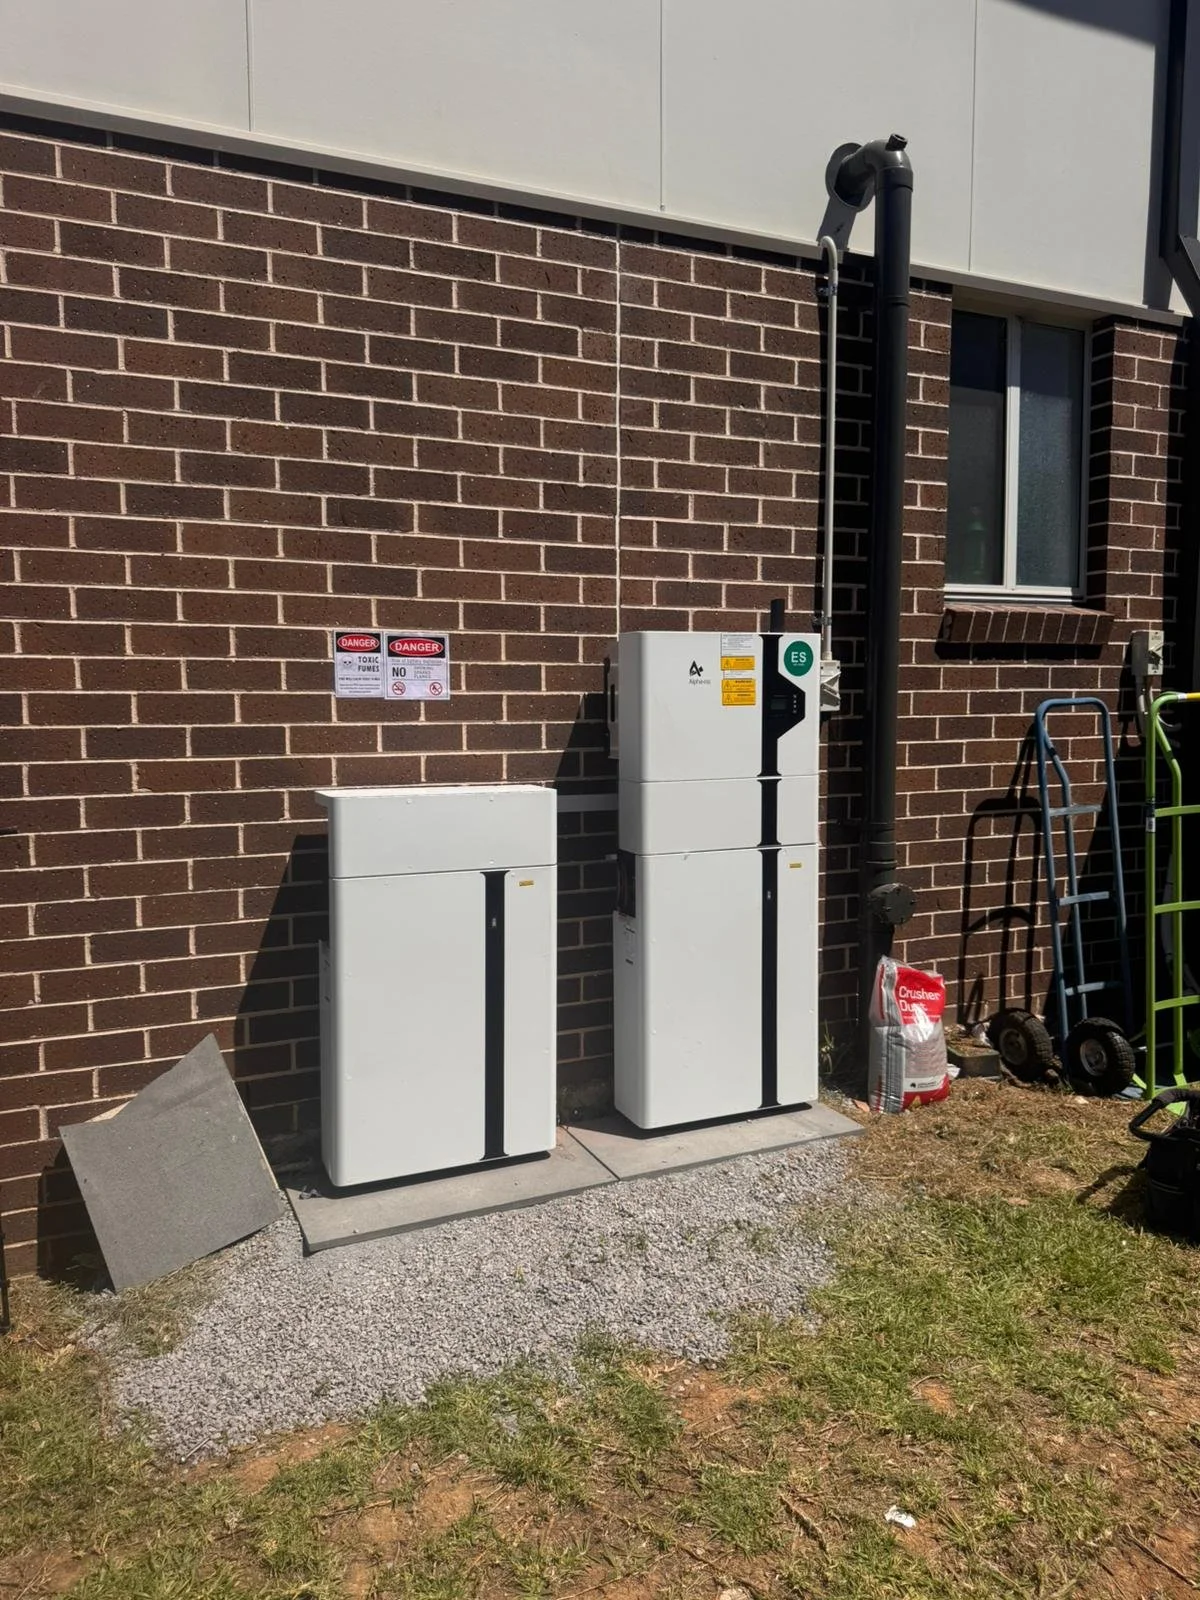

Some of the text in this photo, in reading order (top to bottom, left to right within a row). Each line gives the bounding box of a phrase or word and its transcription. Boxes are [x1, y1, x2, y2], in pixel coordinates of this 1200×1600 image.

[341, 638, 377, 648] DANGER
[394, 642, 440, 652] DANGER
[358, 656, 379, 664] TOXIC
[791, 651, 807, 663] ES
[392, 666, 407, 677] NO
[898, 986, 942, 1001] Crusher
